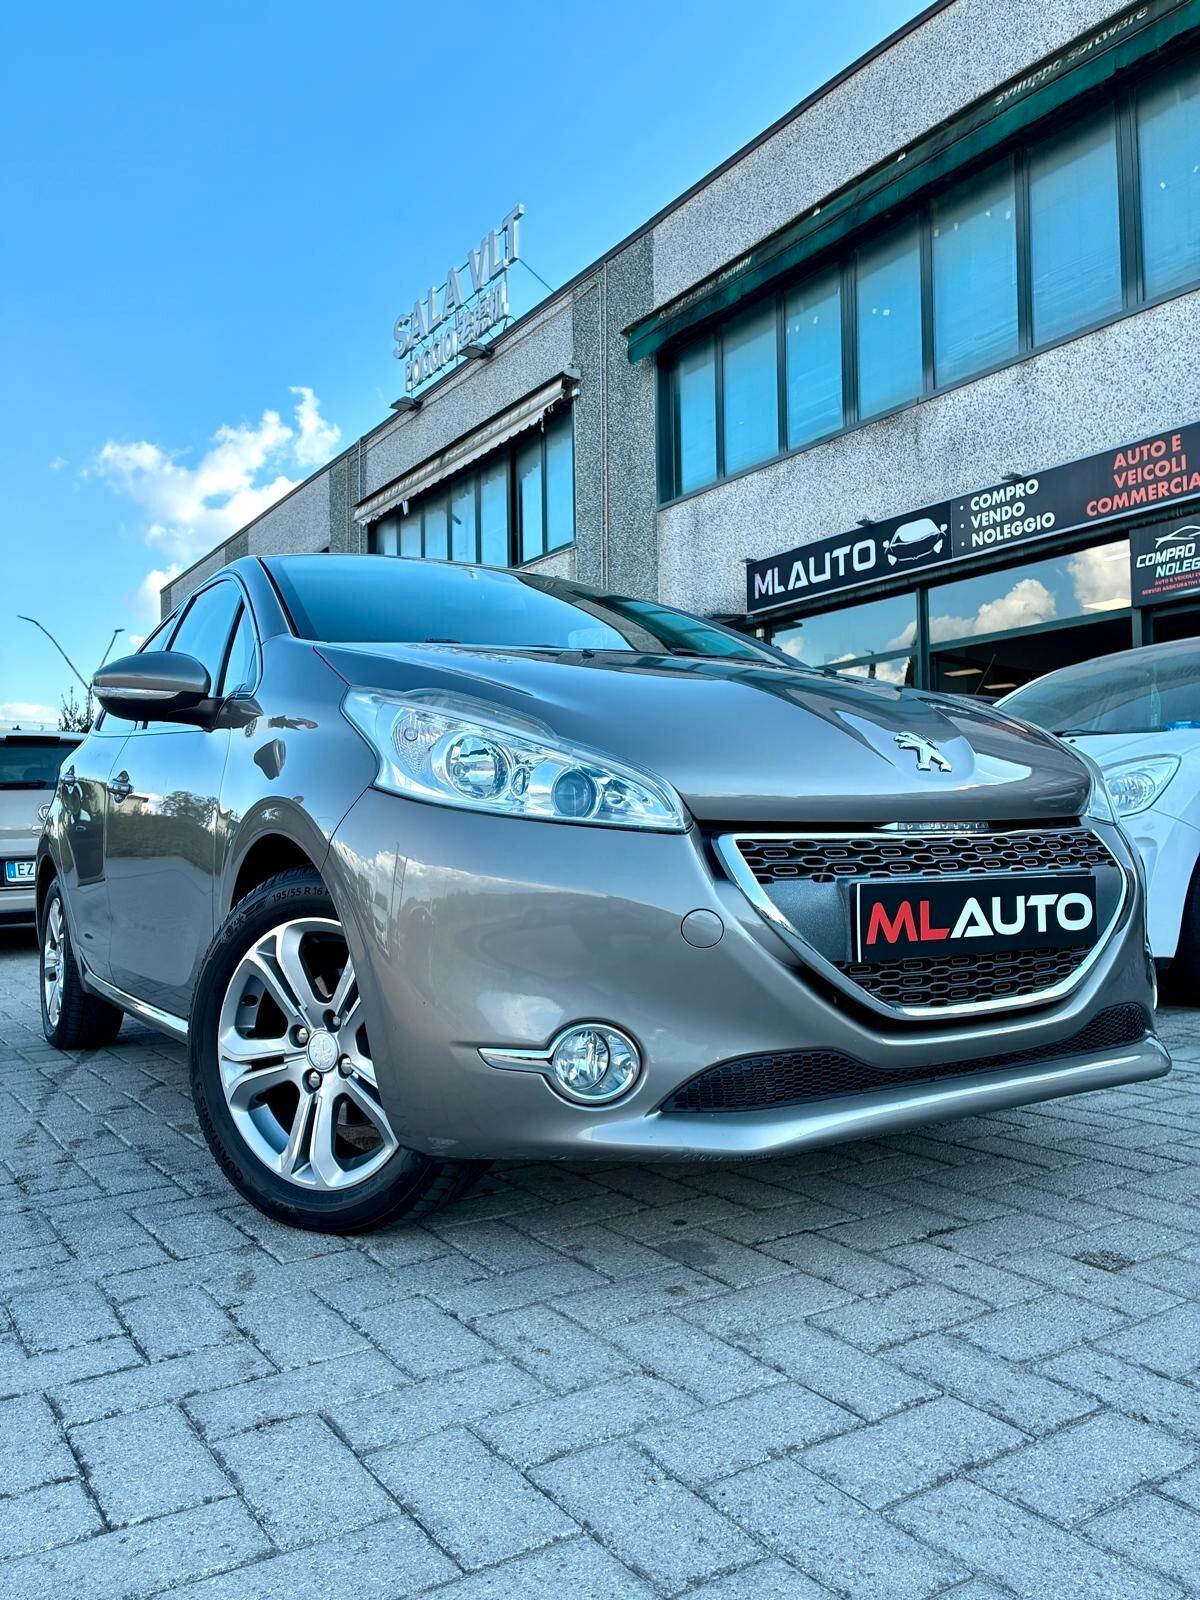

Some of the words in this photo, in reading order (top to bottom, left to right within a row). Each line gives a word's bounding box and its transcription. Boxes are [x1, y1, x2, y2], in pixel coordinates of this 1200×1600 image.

[993, 57, 1063, 106] Sviluppo
[393, 267, 465, 360] SALA
[468, 203, 525, 294] VLT
[405, 326, 458, 392] POGGIO
[1113, 440, 1167, 470] AUTO
[1171, 433, 1182, 452] E
[1113, 454, 1187, 489] VEICOLI
[970, 479, 1039, 512] COMPRO
[1086, 471, 1200, 517] COMMERCIA
[970, 501, 1026, 529] VENDO
[971, 512, 1056, 547] NOLEGGIO
[1135, 543, 1196, 569] COMPRO
[1155, 556, 1200, 578] NOLEG
[17, 863, 35, 876] EZ
[271, 887, 301, 902] 195/55
[303, 886, 311, 895] R
[313, 887, 323, 896] 16
